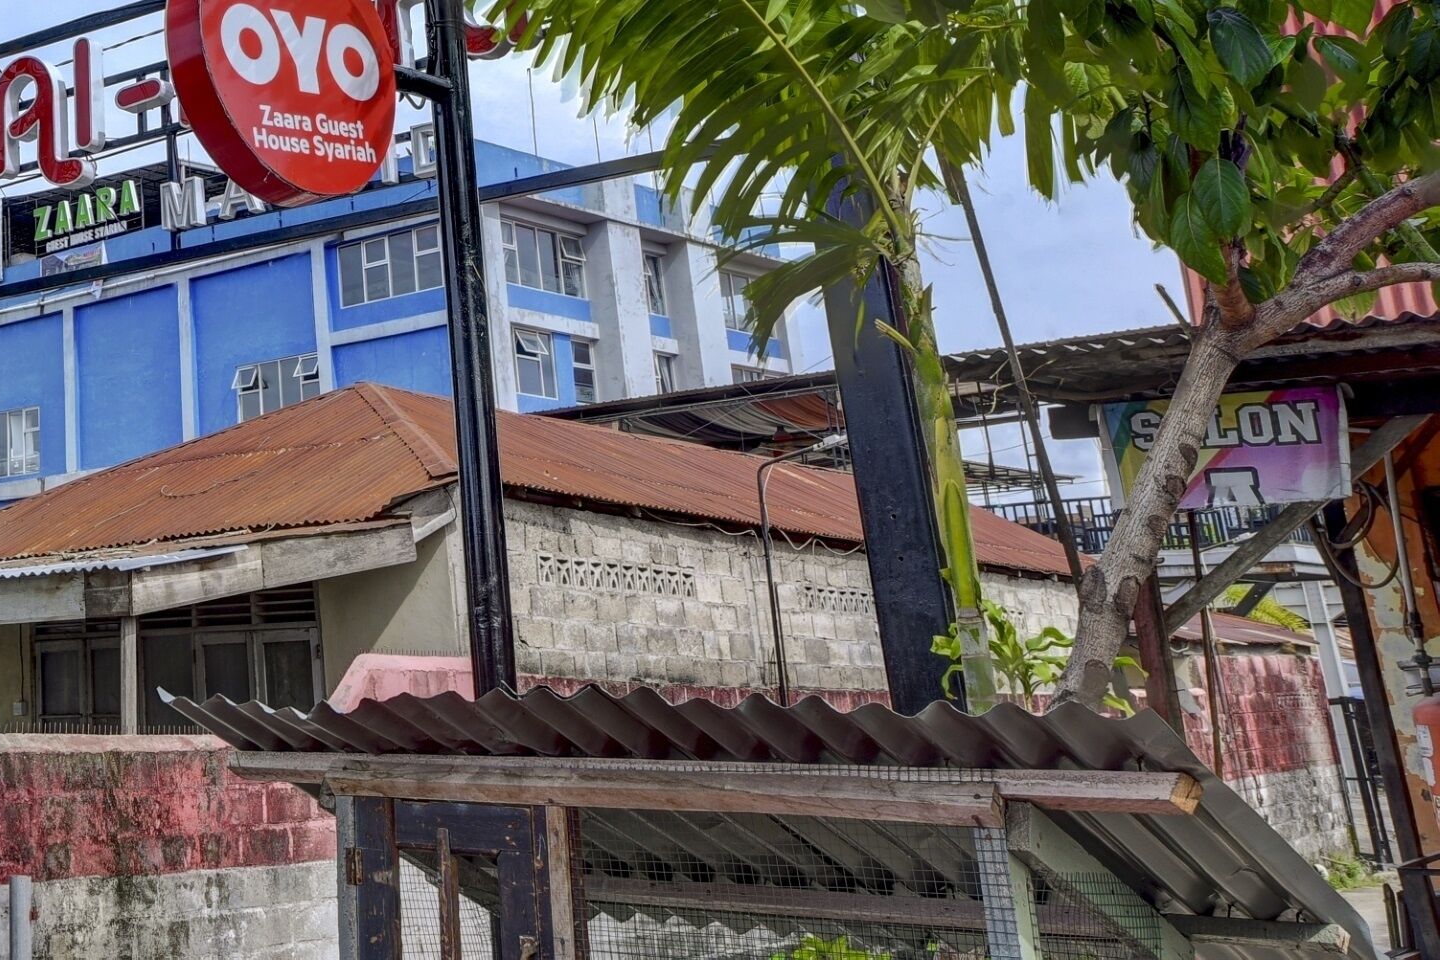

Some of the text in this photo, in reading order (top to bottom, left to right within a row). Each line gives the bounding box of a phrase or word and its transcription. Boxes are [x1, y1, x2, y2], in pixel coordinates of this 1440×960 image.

[220, 3, 380, 101] OYO
[252, 126, 310, 154] House
[312, 135, 377, 164] Syariah
[259, 104, 364, 139] Zaara Guest
[33, 179, 140, 241] ZAARA
[1128, 400, 1322, 452] SLON
